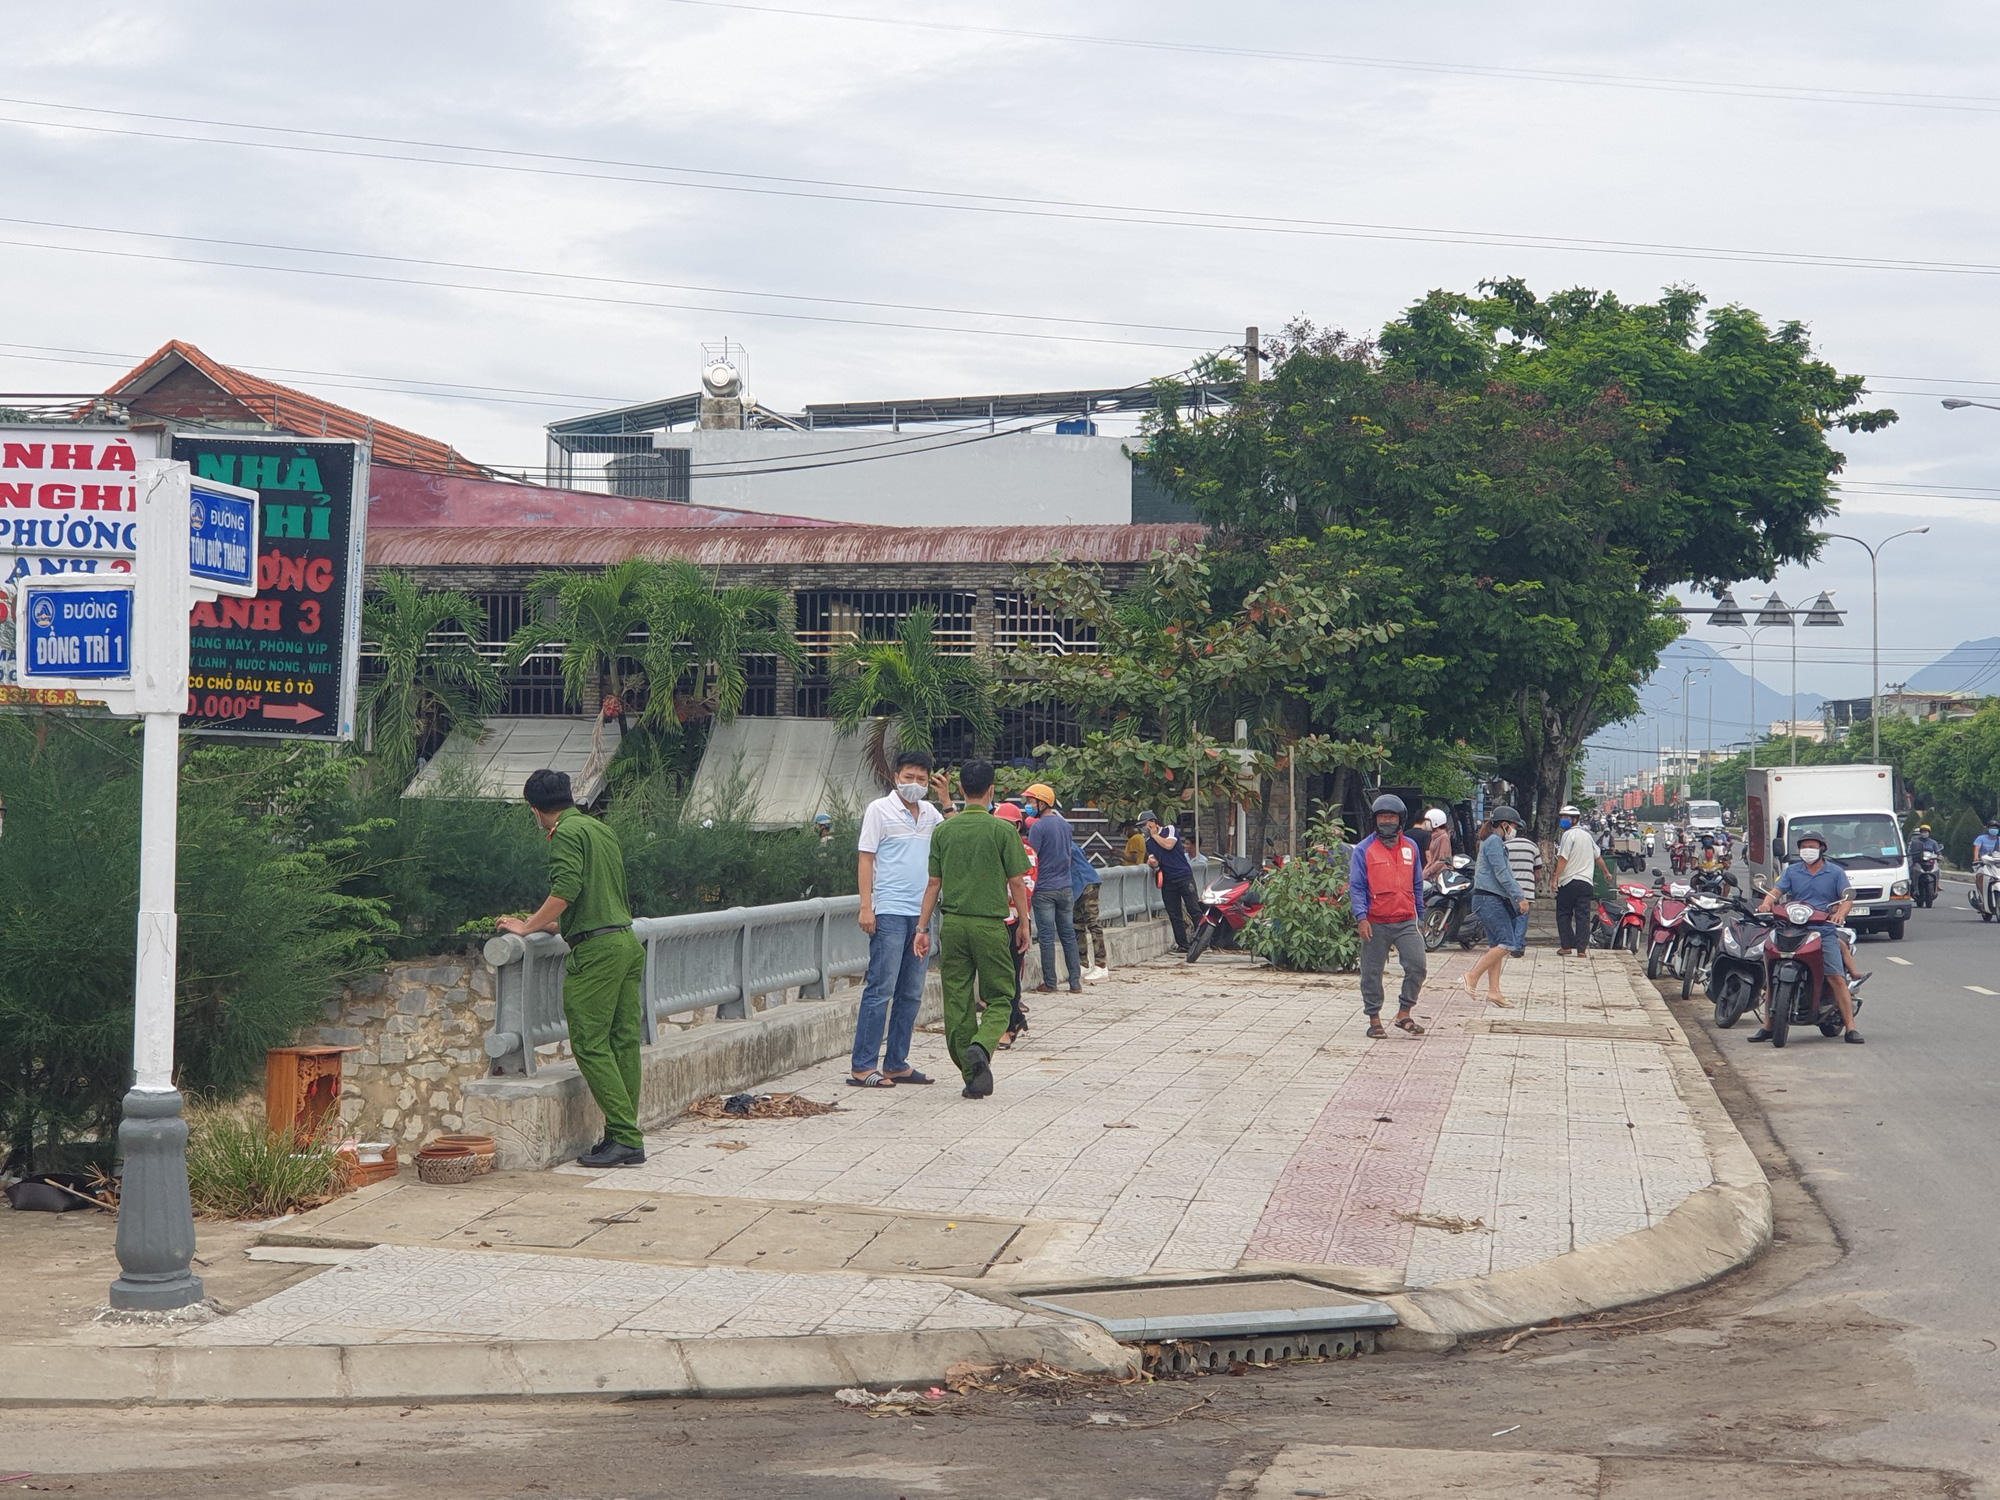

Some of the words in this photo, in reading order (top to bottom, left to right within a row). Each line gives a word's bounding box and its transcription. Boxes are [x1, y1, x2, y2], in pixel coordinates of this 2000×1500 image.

[3, 438, 136, 471] NHÀ
[197, 448, 323, 491] NHÀ
[210, 506, 245, 531] ĐƯỜNG
[260, 494, 332, 540] HỈ
[191, 531, 206, 566] TÔN
[207, 531, 222, 569] ĐỨC
[223, 533, 246, 574] THẮNG
[257, 549, 334, 593] ƠNG
[63, 597, 118, 619] ĐƯỜNG
[190, 598, 282, 631] ANH
[298, 600, 321, 634] 3
[36, 626, 80, 665] ĐỒNG
[84, 628, 110, 664] TRÍ
[114, 635, 122, 663] 1
[190, 637, 221, 649] HANG
[259, 637, 303, 654] PHÒNG
[188, 673, 204, 687] CÓ
[207, 673, 233, 690] CHỖ
[236, 676, 262, 694] ĐẬU
[265, 680, 281, 693] XE
[284, 678, 294, 694] Ô
[297, 679, 314, 695] TÔ
[309, 662, 332, 674] WIFI
[186, 694, 262, 719] 0.000đ
